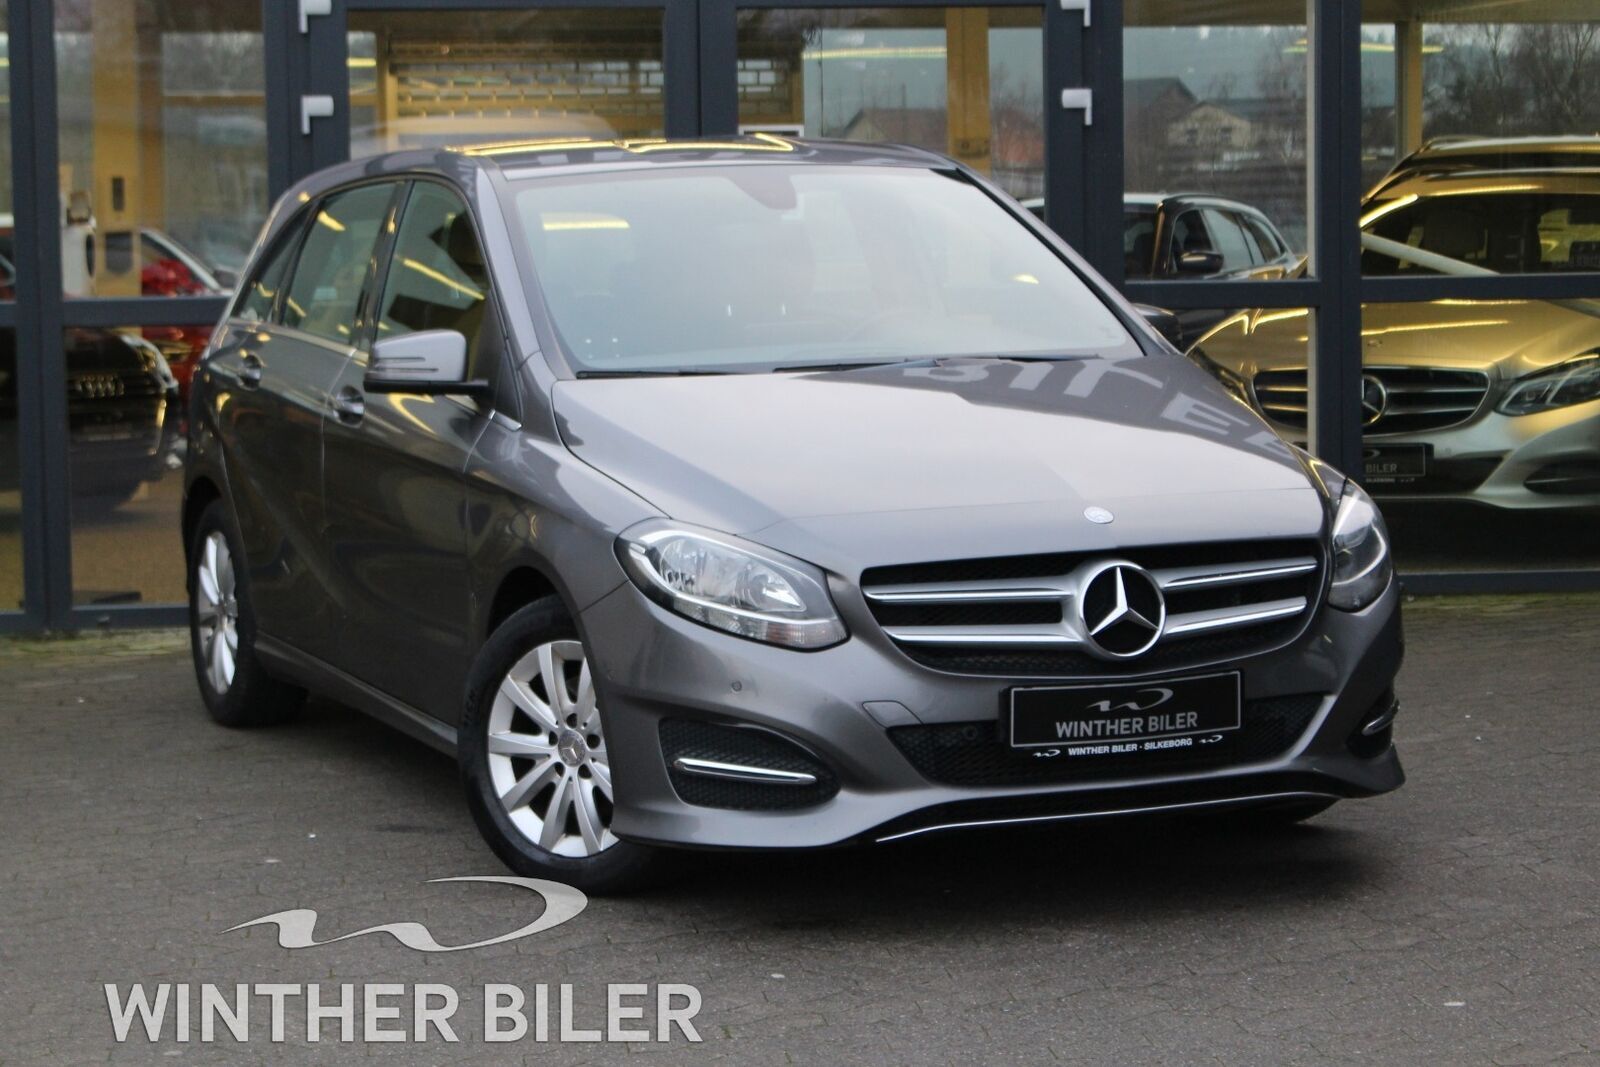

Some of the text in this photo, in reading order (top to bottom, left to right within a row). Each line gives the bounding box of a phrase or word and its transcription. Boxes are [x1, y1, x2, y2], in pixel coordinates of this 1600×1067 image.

[1055, 711, 1198, 739] WINTHER BILER
[1068, 738, 1193, 756] WINTHER BILER SILKEBORG
